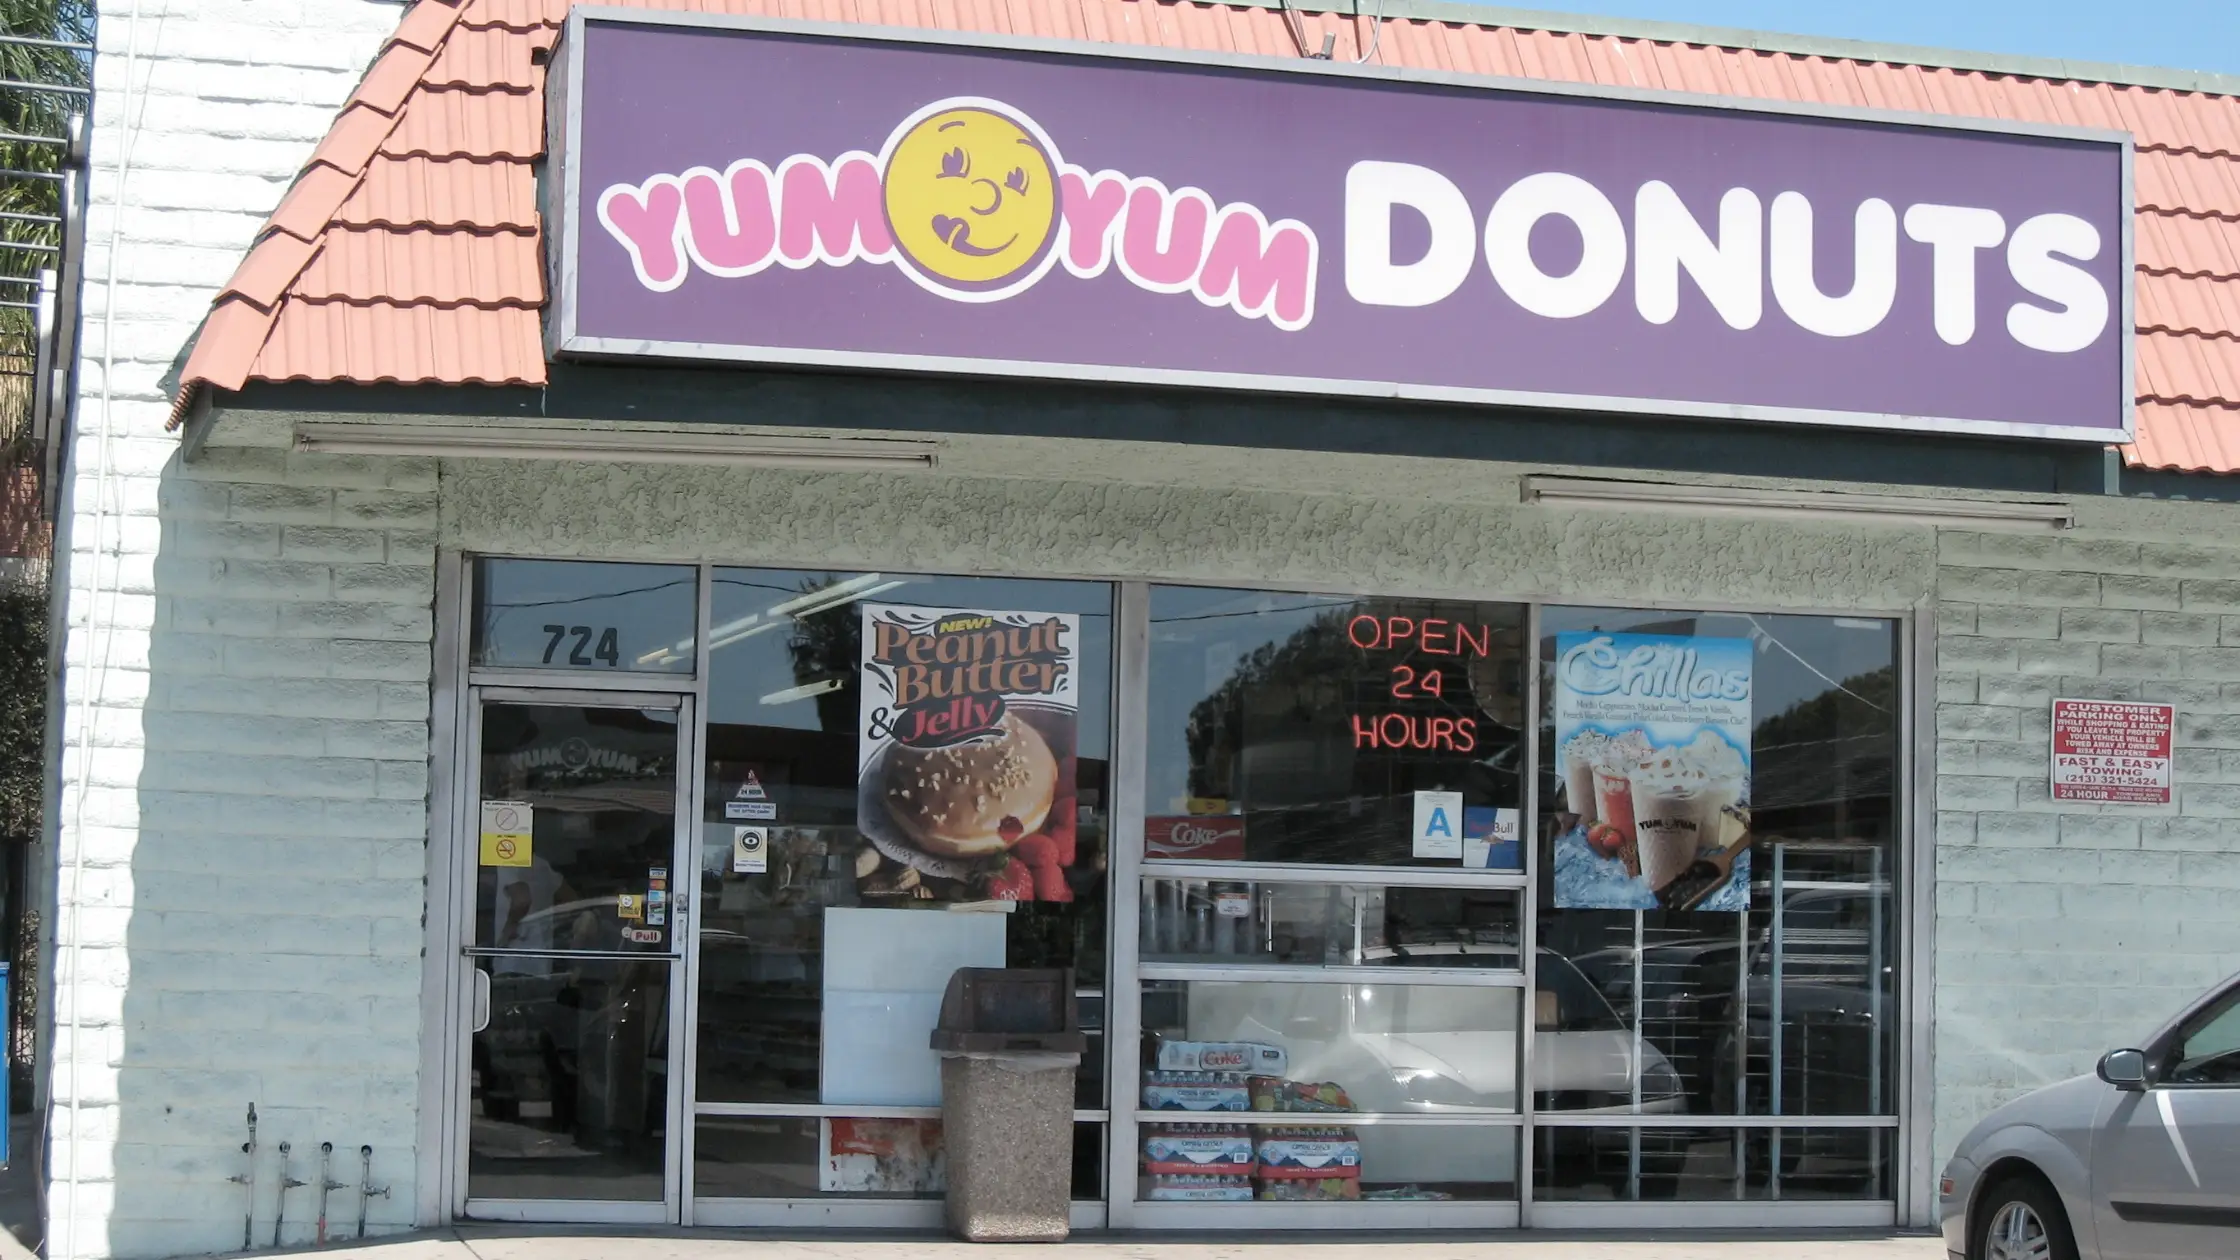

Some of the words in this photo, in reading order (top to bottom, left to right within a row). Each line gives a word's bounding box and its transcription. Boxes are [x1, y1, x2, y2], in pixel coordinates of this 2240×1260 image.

[598, 150, 892, 292] YUM
[1054, 164, 1318, 332] YUM
[1344, 160, 2109, 354] DONUTS
[939, 617, 993, 633] NEW!
[872, 616, 1070, 665] Peanut
[1349, 615, 1488, 657] OPEN
[542, 624, 619, 667] 724
[1560, 636, 1749, 703] Chillas
[893, 656, 1069, 709] Butter
[1392, 665, 1442, 698] 24
[2066, 703, 2160, 715] CUSTOMER
[868, 706, 896, 740] &
[902, 697, 1000, 743] Jelly
[2057, 718, 2083, 727] WHILE
[2086, 720, 2128, 728] SHOPPING
[2059, 710, 2124, 721] PARKING
[2128, 714, 2167, 723] ONLY
[1352, 713, 1476, 752] HOURS
[2084, 726, 2108, 735] LEAVE
[2110, 728, 2125, 736] THE
[2126, 729, 2166, 737] PROPERTY
[2093, 734, 2124, 742] VEHICLE
[2126, 735, 2145, 743] WILL
[2065, 740, 2092, 748] TOWED
[2093, 741, 2114, 749] AWAY
[2076, 747, 2094, 755] RISK
[2096, 748, 2112, 756] AND
[2114, 749, 2148, 757] EXPENSE
[2059, 757, 2098, 766] FAST
[2105, 757, 2115, 766] &
[2121, 758, 2164, 770] EASY
[2081, 766, 2143, 776] TOWING
[2065, 774, 2096, 783] (213)
[2101, 775, 2158, 786] 321-5424
[2060, 790, 2074, 798] 24
[2076, 790, 2108, 799] HOUR
[1425, 807, 1452, 837] A
[1171, 822, 1218, 845] Coke
[635, 931, 657, 941] Pull
